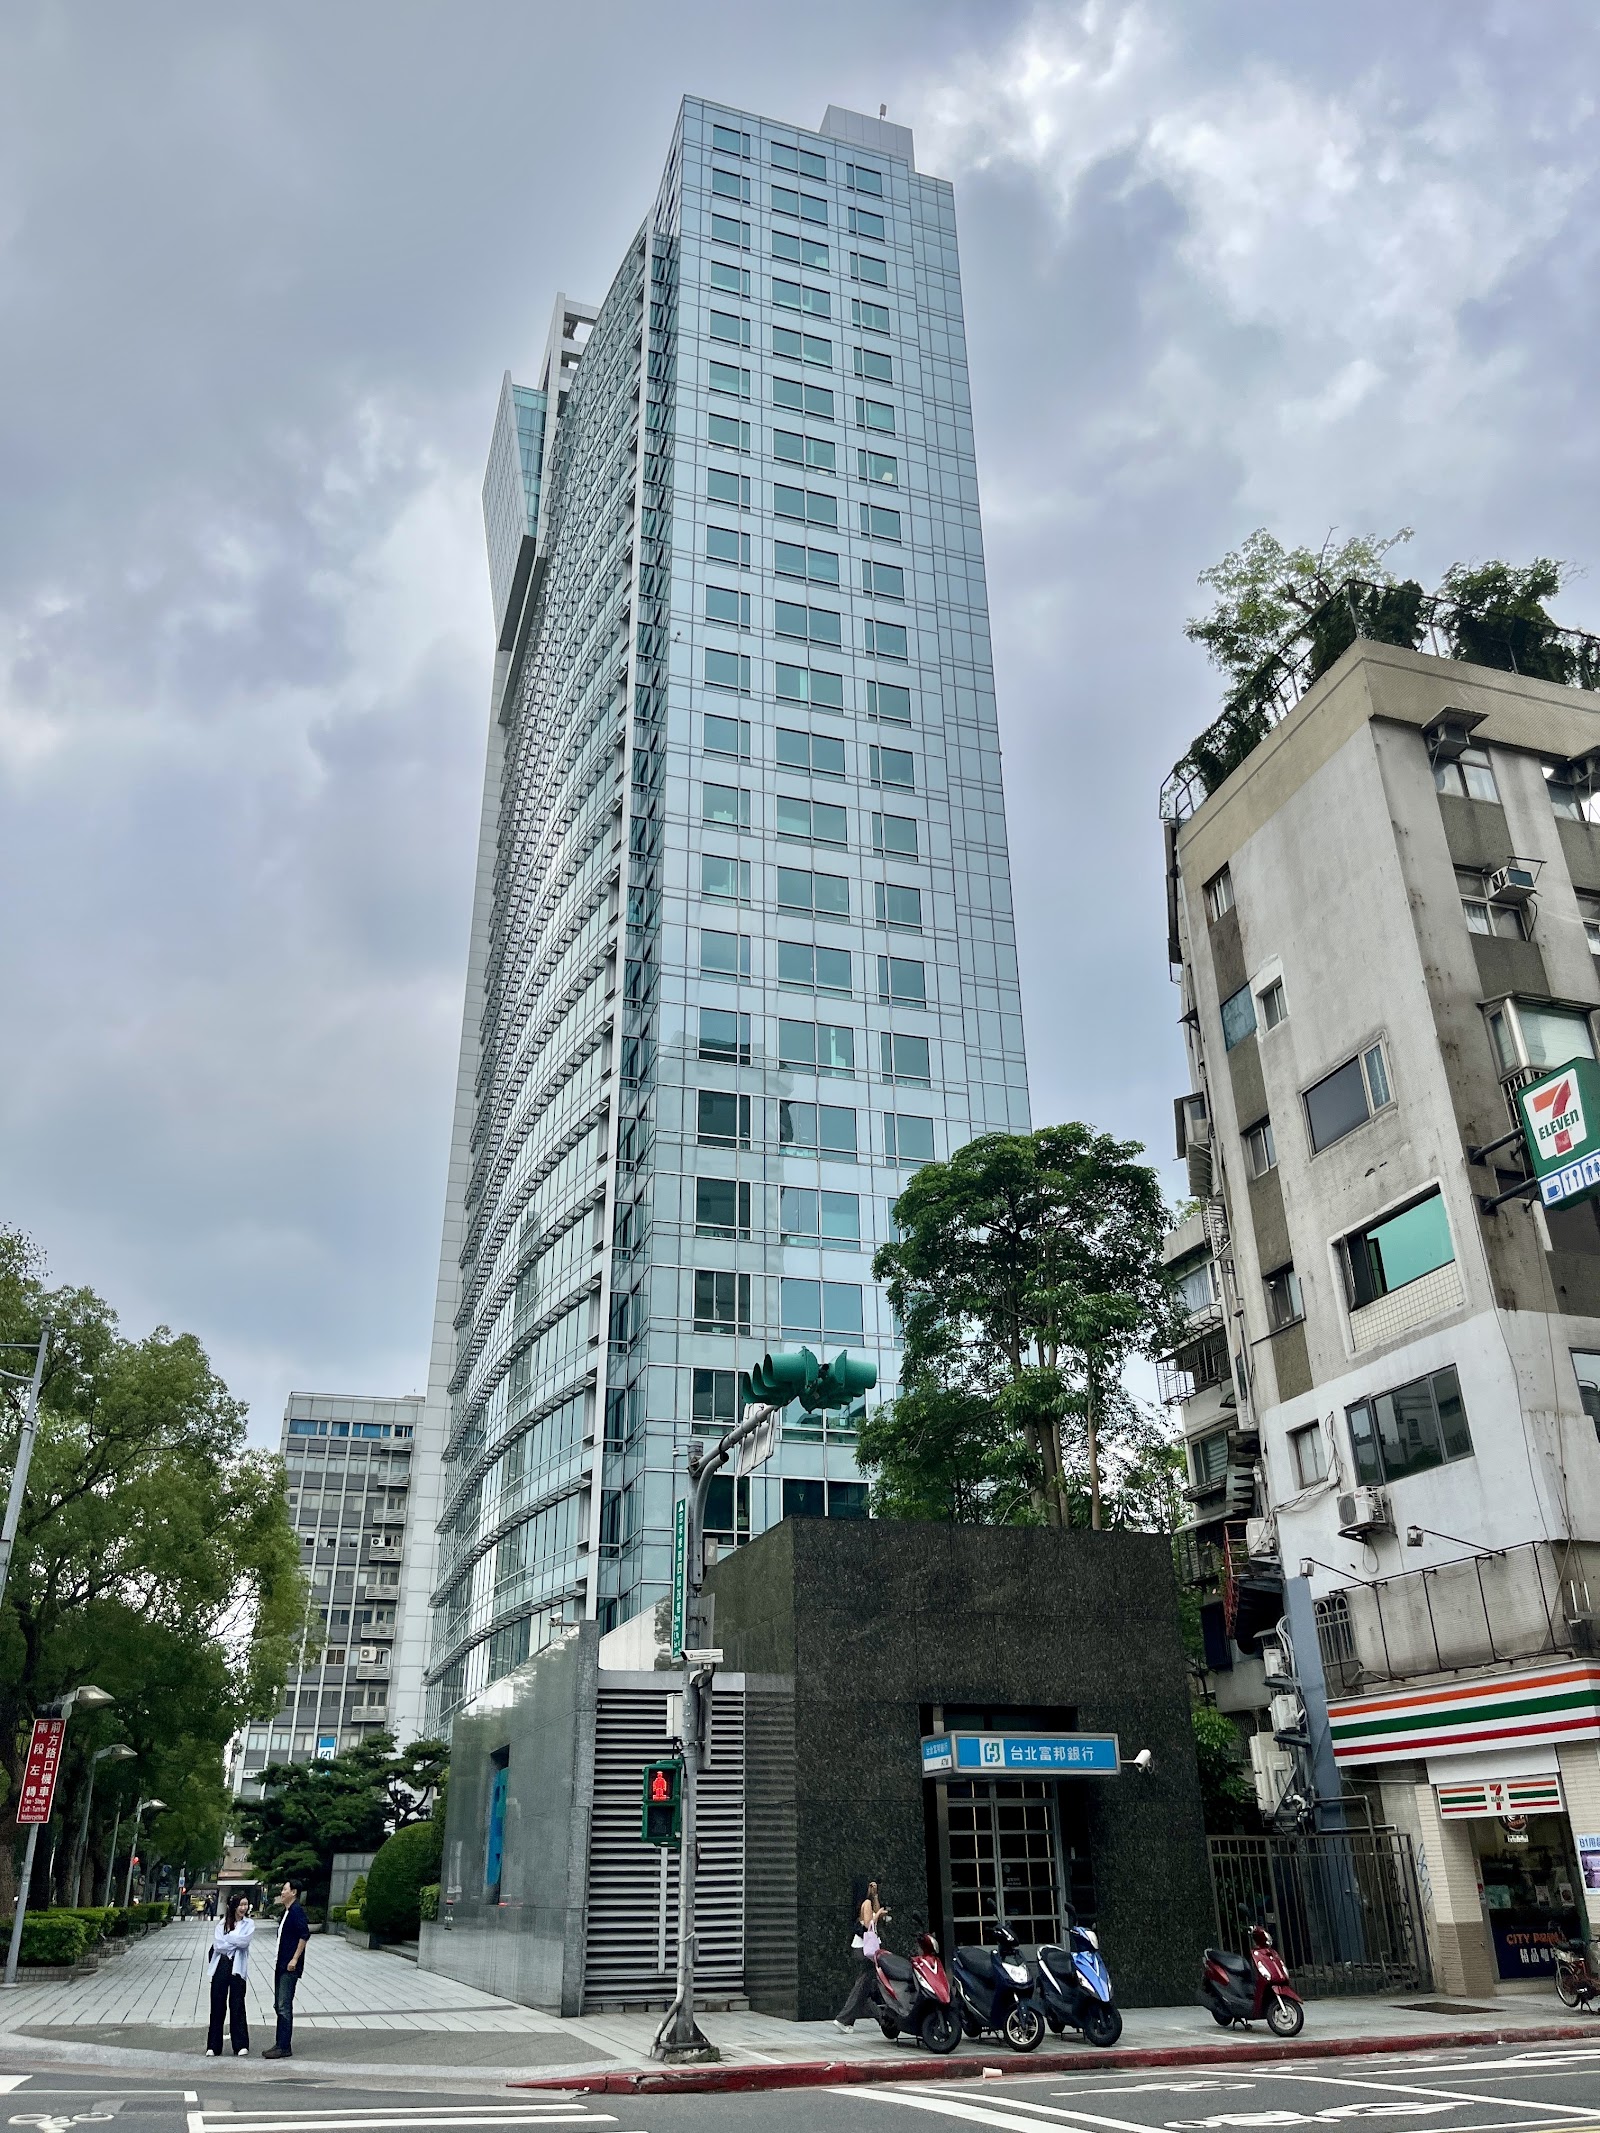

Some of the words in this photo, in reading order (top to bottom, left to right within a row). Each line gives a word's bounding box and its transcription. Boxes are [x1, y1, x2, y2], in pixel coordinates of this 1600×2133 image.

[1532, 1079, 1572, 1155] 7
[25, 1722, 48, 1797] 兩段左轉
[39, 1722, 62, 1797] 前方路口機車
[1010, 1745, 1094, 1761] 台北富邦銀行
[1489, 1783, 1502, 1811] 7
[1506, 1933, 1530, 1945] CITY
